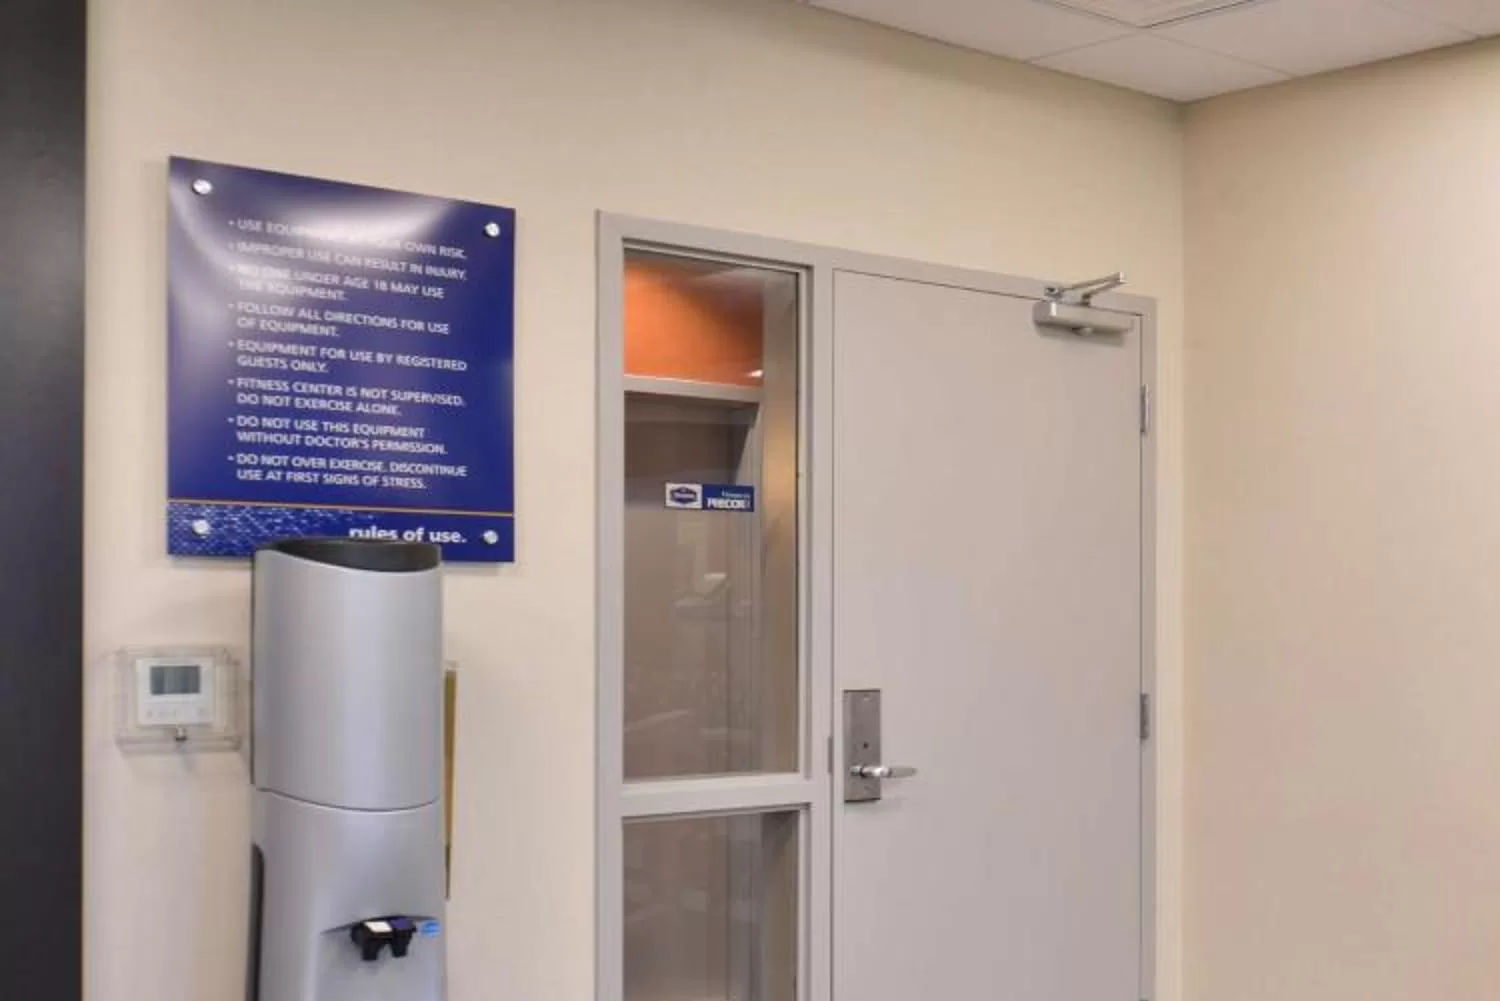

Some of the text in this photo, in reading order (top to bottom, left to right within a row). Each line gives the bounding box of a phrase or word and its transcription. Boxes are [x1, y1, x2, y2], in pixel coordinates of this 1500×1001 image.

[238, 218, 467, 260] USE OWN RISK.
[364, 257, 408, 273] RESULT
[410, 263, 423, 275] IN
[343, 275, 369, 290] AGE
[375, 280, 388, 292] 18
[391, 281, 420, 296] MAY
[422, 285, 445, 300] USE
[238, 301, 450, 335] FOLLOW ALL DIRECTIONS FOR USE
[260, 319, 340, 337] EQUIPMENT.
[237, 355, 288, 369] GUESTS
[238, 339, 468, 371] EQUIPMENT FOR USE BY REGISTERED
[237, 377, 290, 393] FITNESS
[292, 381, 343, 397] CENTER
[345, 386, 357, 397] IS
[360, 387, 388, 400] NOT
[237, 392, 259, 405] DO
[261, 395, 290, 407] NOT
[295, 397, 353, 412] EXERCISE
[237, 415, 426, 438] DO NOT USE THIS EQUIPMENT
[236, 431, 300, 446] WITHOUT
[304, 435, 369, 450] DOCTOR'S
[237, 453, 259, 465] DO
[261, 455, 289, 467] NOT
[292, 456, 327, 470] OVER
[389, 462, 469, 477] DISCONTINUE
[237, 469, 428, 489] USE AT FIRST SIGNS OF STRESS.
[348, 525, 467, 543] rules of use.
